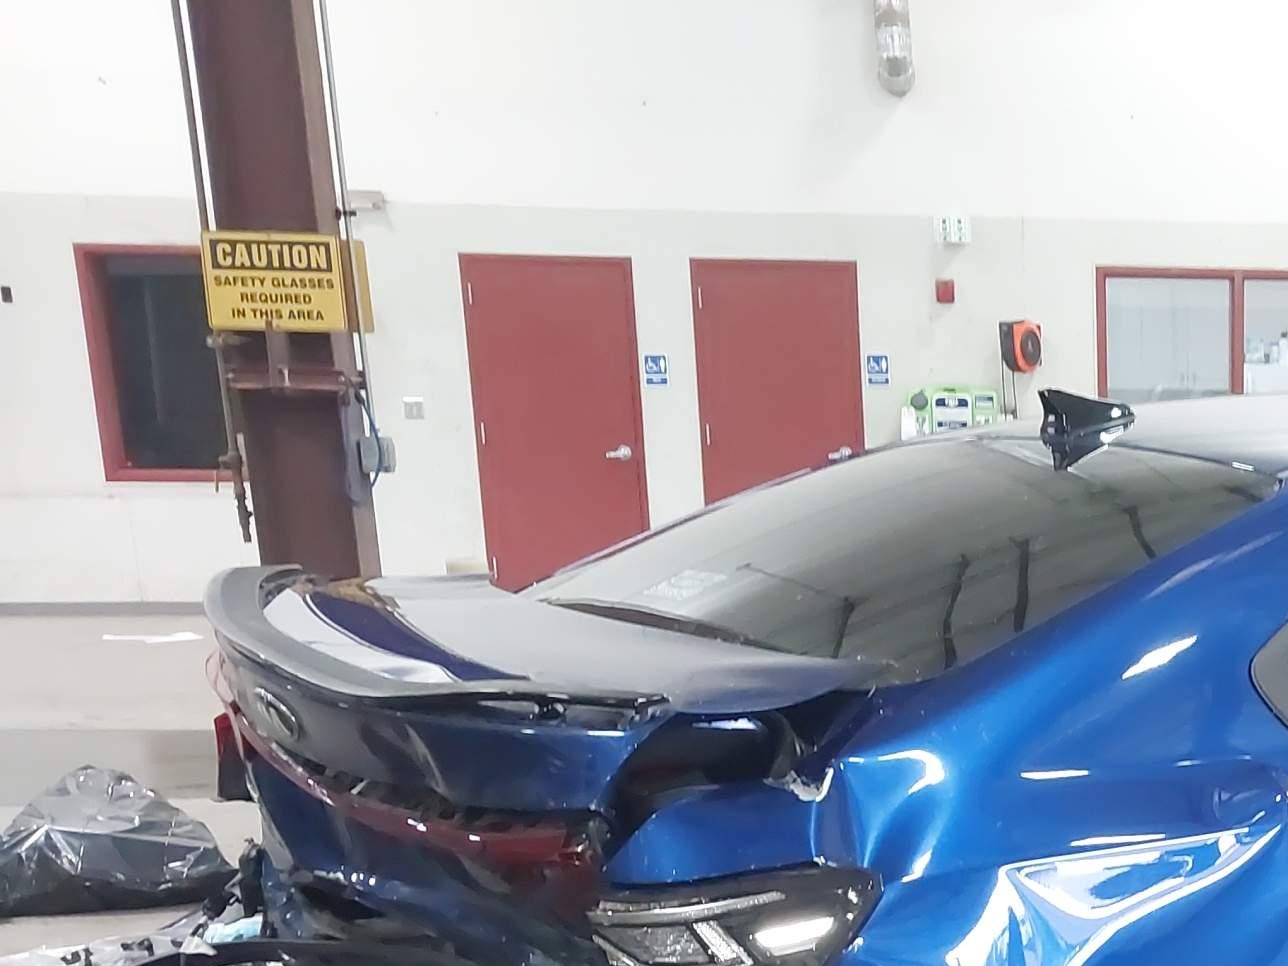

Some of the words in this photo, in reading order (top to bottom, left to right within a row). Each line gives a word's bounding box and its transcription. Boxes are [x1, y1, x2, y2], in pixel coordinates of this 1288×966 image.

[215, 242, 328, 270] CAUTION
[213, 275, 266, 288] SAFETY
[271, 277, 335, 289] GLASSES
[240, 292, 312, 305] REQUIRED
[231, 308, 246, 319] IN
[250, 308, 283, 321] THIS
[287, 310, 325, 321] AREA
